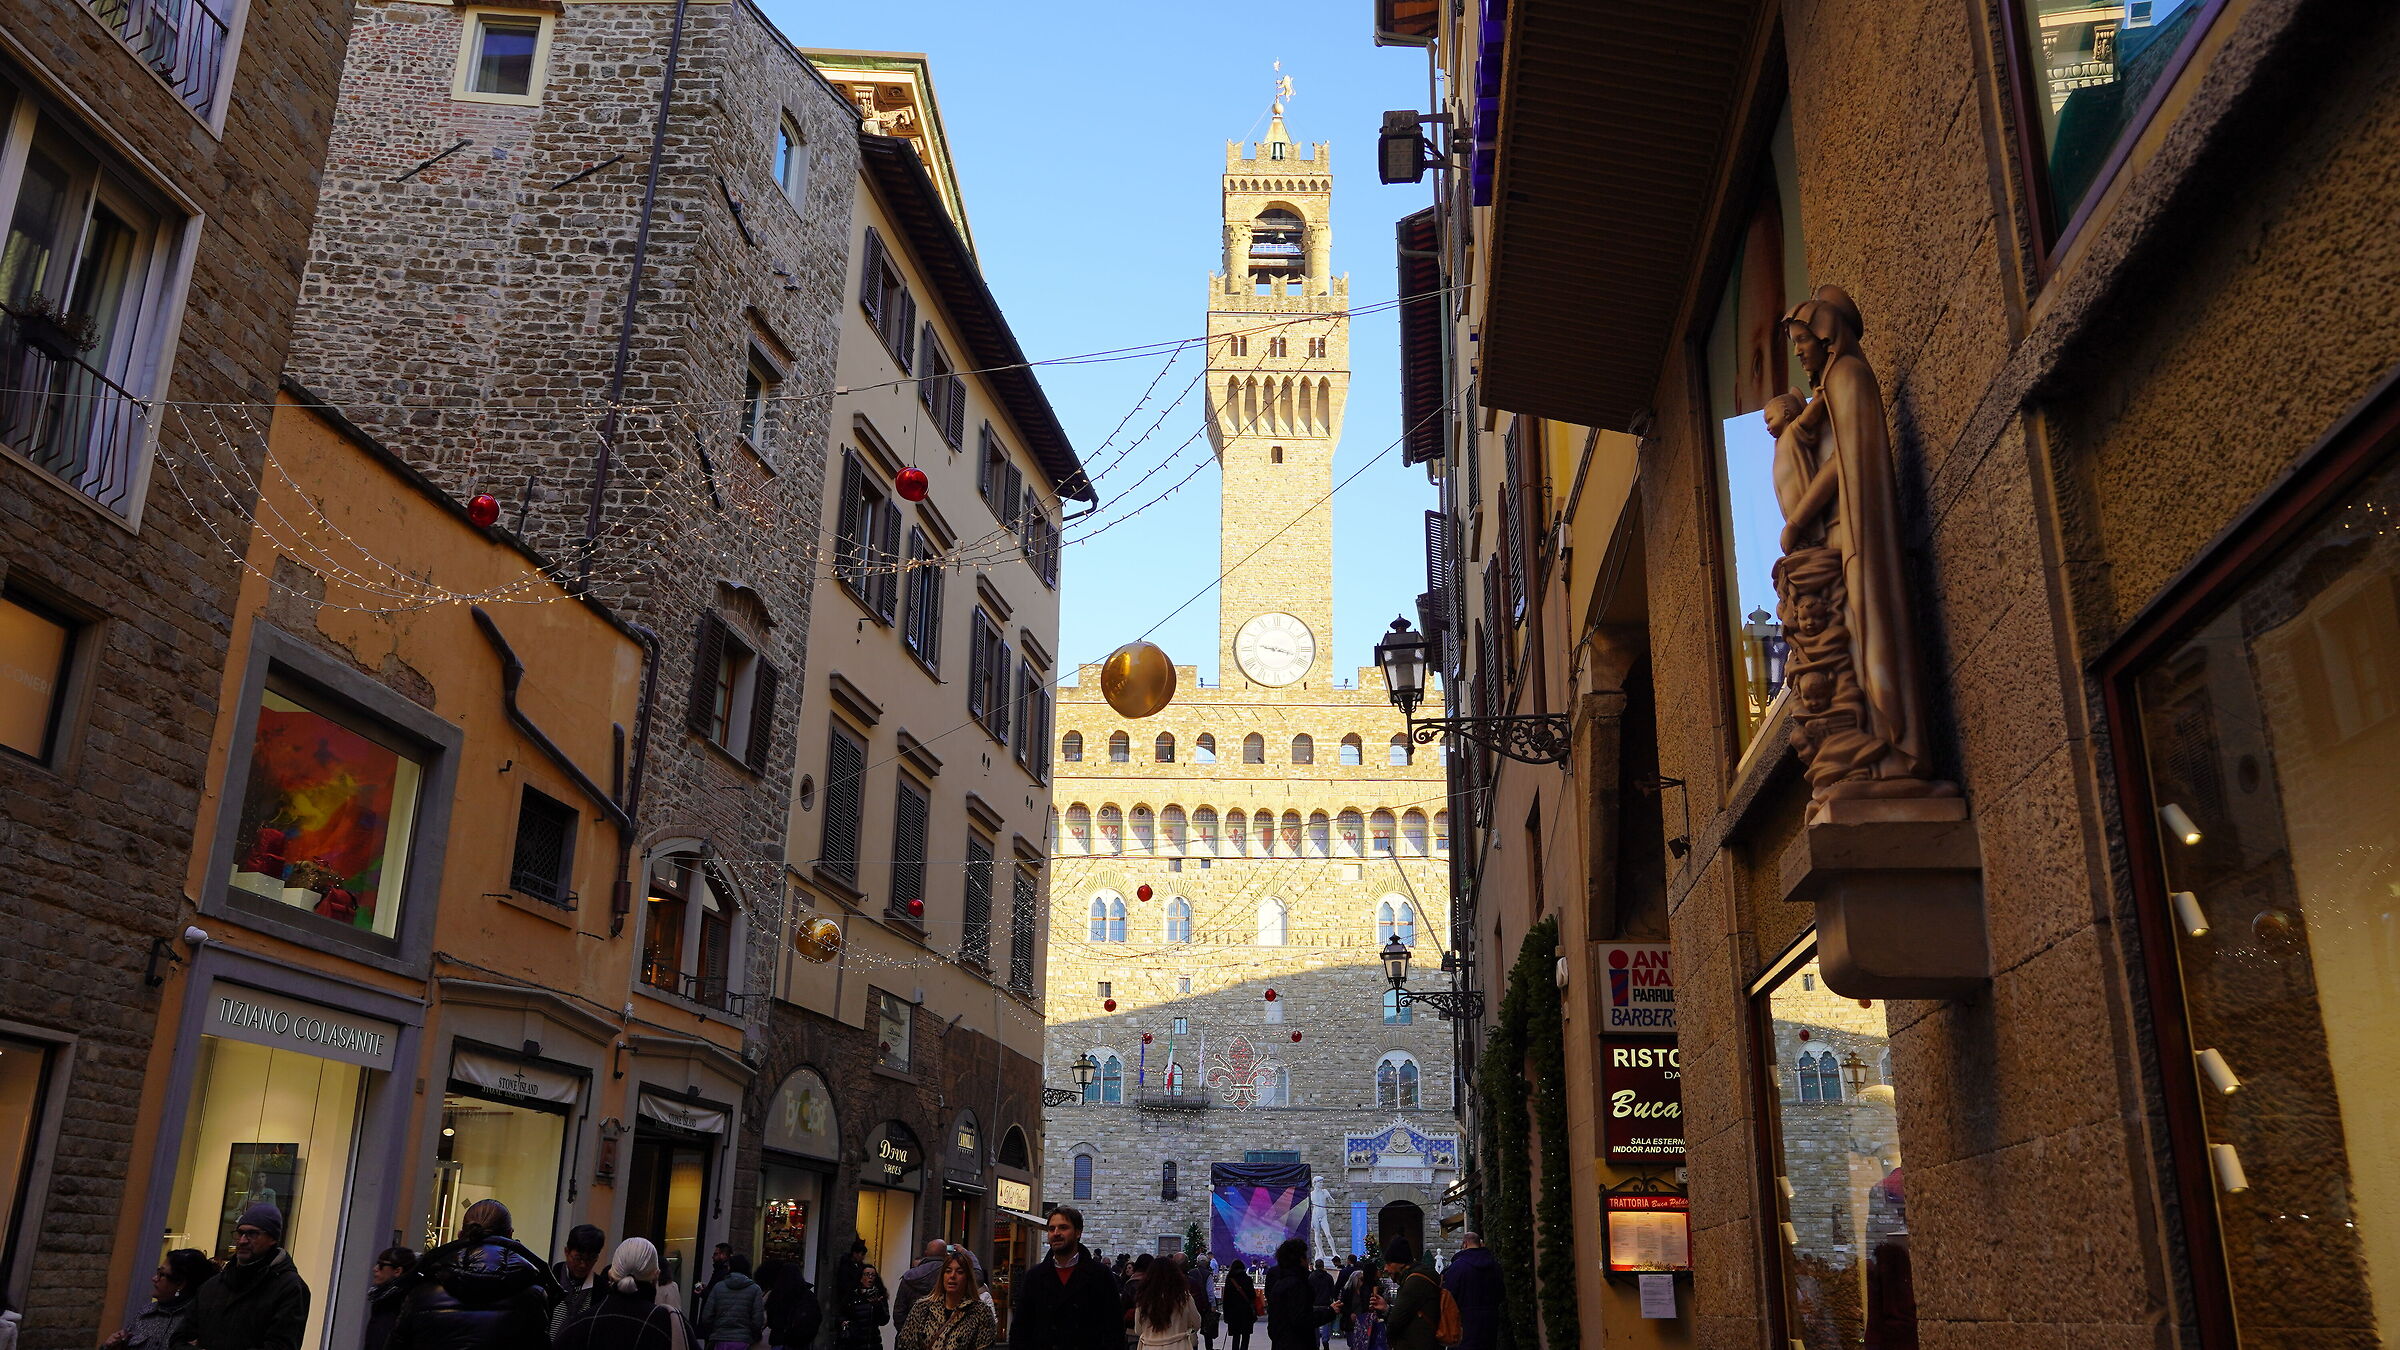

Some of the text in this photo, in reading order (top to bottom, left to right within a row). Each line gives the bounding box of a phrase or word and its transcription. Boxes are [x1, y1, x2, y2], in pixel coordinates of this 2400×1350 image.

[218, 997, 385, 1056] TIZIANO COLASANTE
[1611, 1008, 1677, 1028] BARBER
[1613, 1048, 1680, 1068] RISTO
[498, 1076, 539, 1095] STONE ISLAND
[1611, 1089, 1682, 1119] Buca
[1612, 1145, 1643, 1153] INDOOR
[1663, 1146, 1686, 1154] OUTD
[1630, 1137, 1651, 1145] SALA
[1609, 1198, 1650, 1208] TRATTORIA
[1651, 1200, 1668, 1208] Buca
